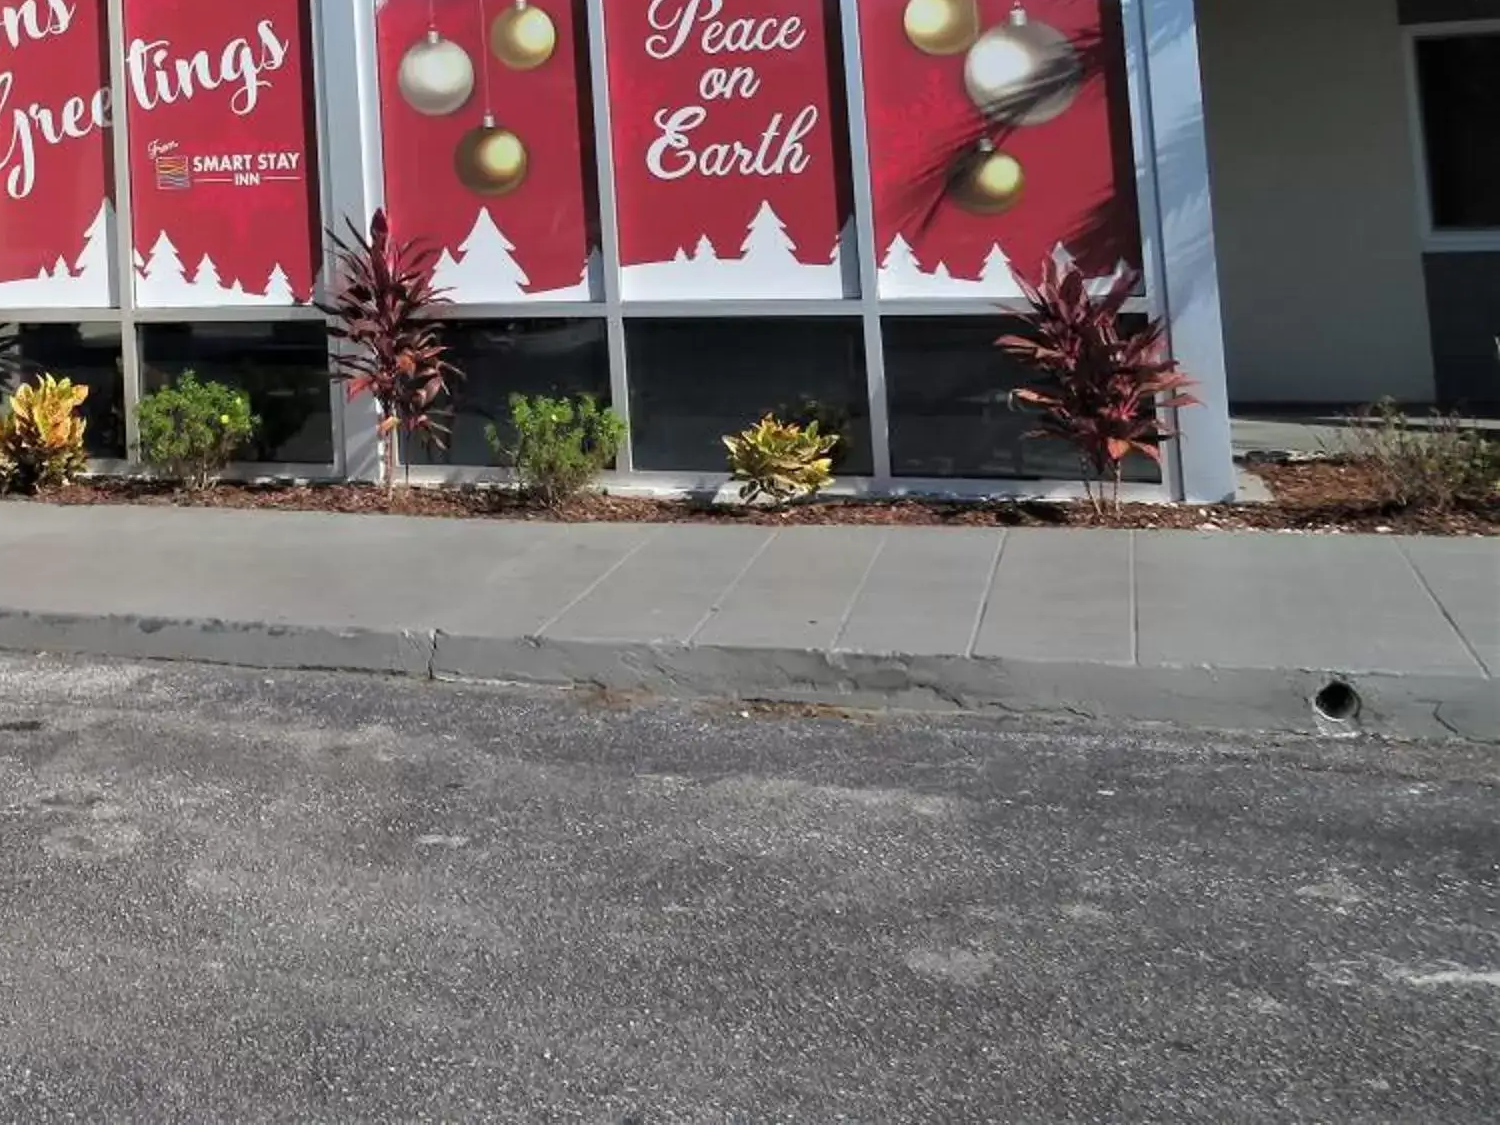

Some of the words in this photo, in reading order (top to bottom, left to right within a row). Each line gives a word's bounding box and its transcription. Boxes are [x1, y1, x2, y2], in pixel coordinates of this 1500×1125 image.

[699, 65, 761, 99] on
[646, 104, 819, 180] Earth
[192, 154, 252, 173] SMART
[257, 152, 300, 171] STAY
[234, 173, 260, 186] INN
